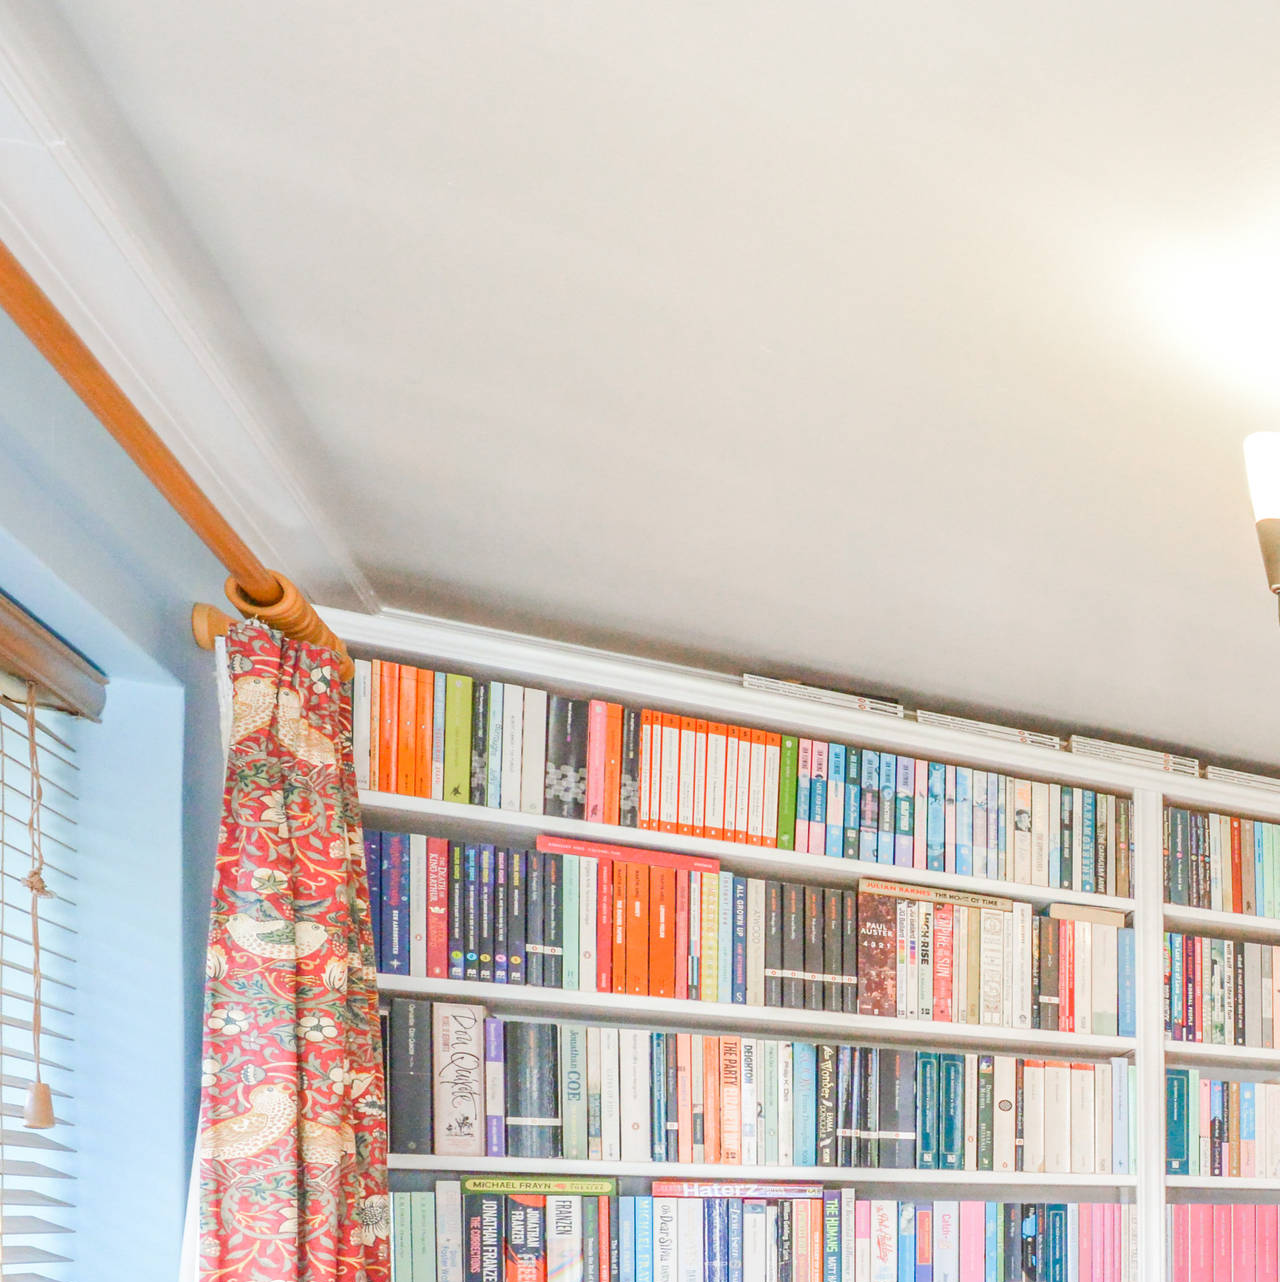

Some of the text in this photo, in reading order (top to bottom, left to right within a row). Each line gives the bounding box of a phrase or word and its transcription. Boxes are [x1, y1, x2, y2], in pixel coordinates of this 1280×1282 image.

[429, 853, 438, 902] KING ARTHUR
[438, 867, 447, 890] DEATH
[866, 881, 932, 897] JULIAN BARNES
[736, 884, 744, 937] ALL GROWN UP
[866, 922, 888, 931] PAUL
[860, 928, 893, 938] AUSTER
[934, 913, 951, 977] EMPIRE SUN
[567, 1029, 581, 1102] Jonathan COE
[723, 1041, 738, 1057] THE
[743, 1044, 754, 1084] DEIGHTON
[723, 1058, 738, 1086] PARTY
[820, 1060, 833, 1098] Wonder
[472, 1181, 551, 1189] MICHAEL FRAYN
[482, 1199, 498, 1245] JONATHAN
[555, 1199, 572, 1235] FRANZEN
[827, 1199, 839, 1216] THE
[511, 1210, 524, 1245] FRANZEN
[526, 1208, 540, 1248] JONATHAN
[659, 1215, 673, 1237] Dear
[826, 1217, 839, 1252] HUMANS
[470, 1216, 480, 1273] THE CORRECTIONS
[659, 1237, 674, 1262] Silvia
[827, 1256, 837, 1275] MATT
